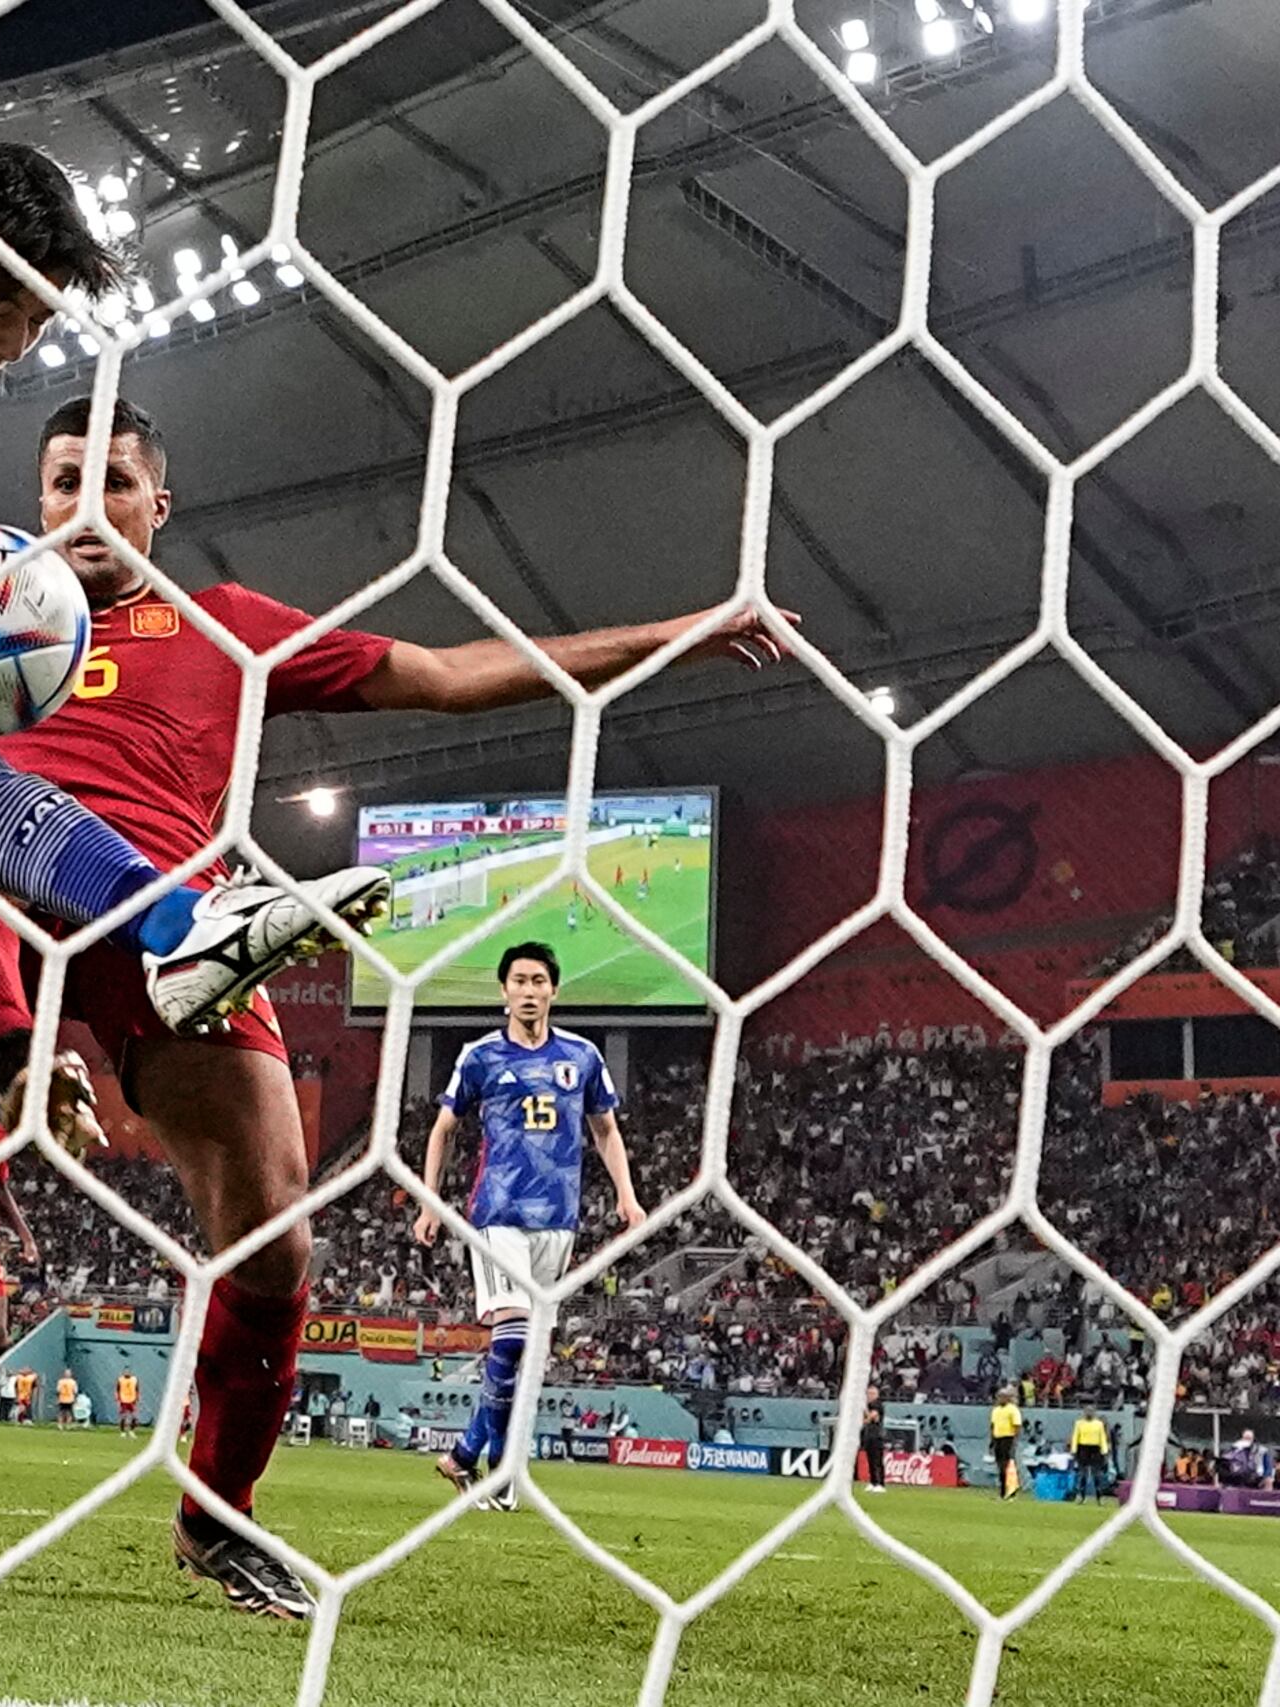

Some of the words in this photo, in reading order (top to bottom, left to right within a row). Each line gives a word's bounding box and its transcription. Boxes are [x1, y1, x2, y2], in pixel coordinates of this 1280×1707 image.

[73, 646, 119, 699] 6
[521, 1095, 556, 1131] 15
[614, 1439, 682, 1466] Budweiser
[726, 1449, 769, 1470] WANDA
